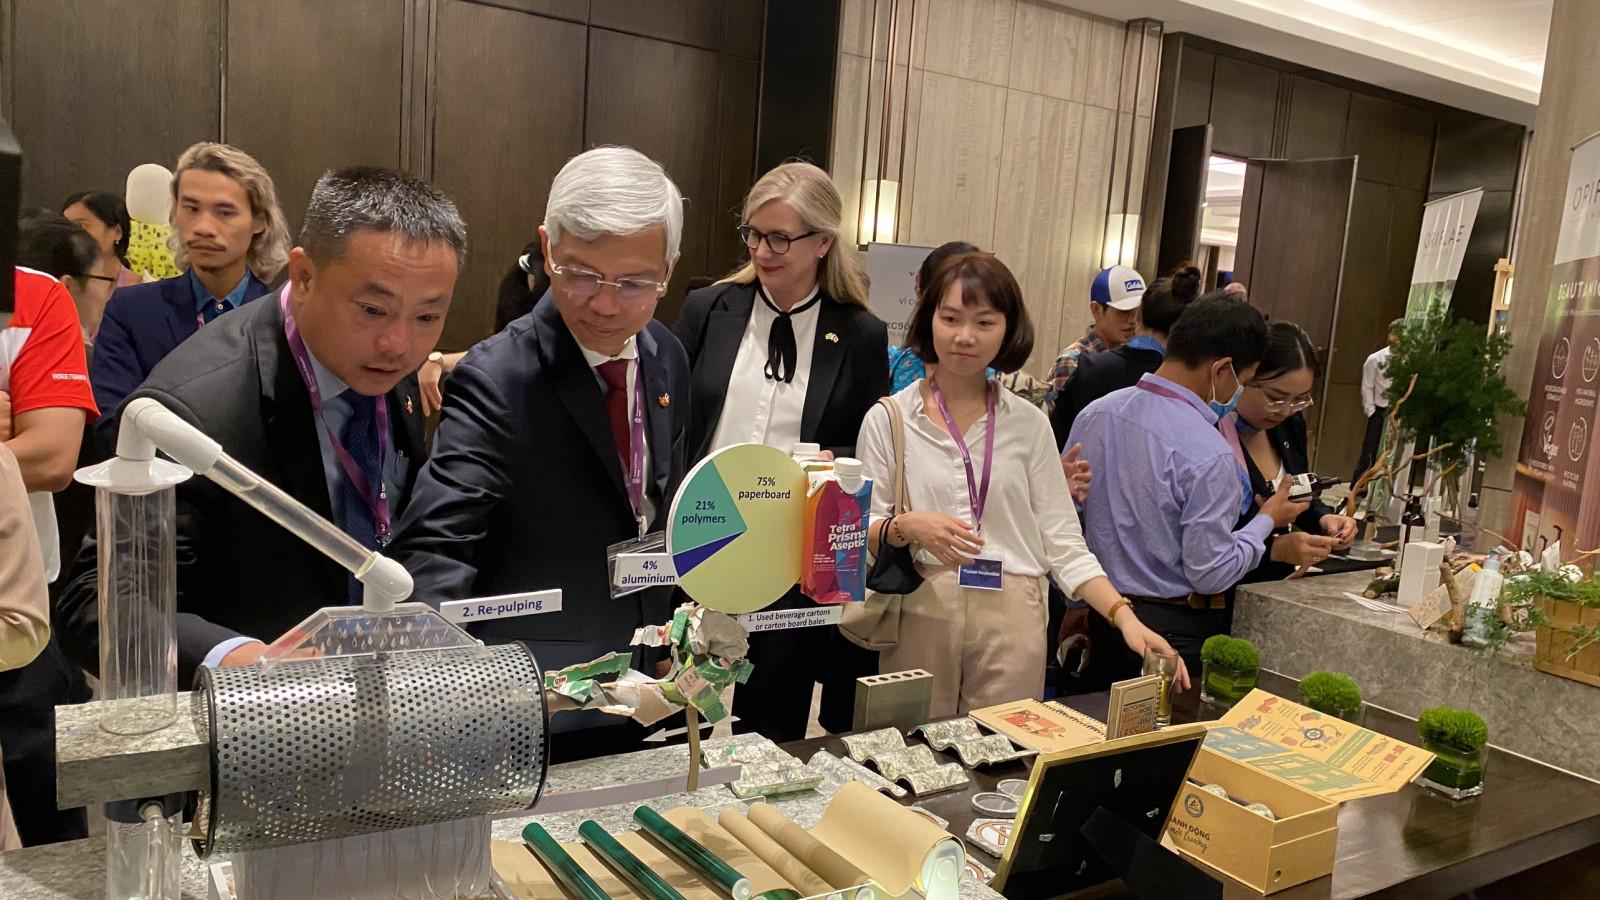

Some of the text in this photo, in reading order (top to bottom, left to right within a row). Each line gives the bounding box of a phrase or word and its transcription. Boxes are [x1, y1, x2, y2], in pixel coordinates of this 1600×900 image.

[757, 477, 776, 487] 75%
[738, 490, 791, 500] paperboard
[695, 501, 716, 510] 21%
[681, 513, 726, 525] polymers
[829, 523, 856, 533] Tetra
[828, 530, 866, 543] Prisma
[830, 539, 865, 551] Aseptic
[642, 560, 658, 570] 4%
[621, 573, 675, 585] aluminium
[463, 600, 542, 617] 2. Re-pulping
[748, 609, 831, 622] 1. Used beverage cartons
[764, 621, 786, 630] carton
[788, 619, 807, 627] board
